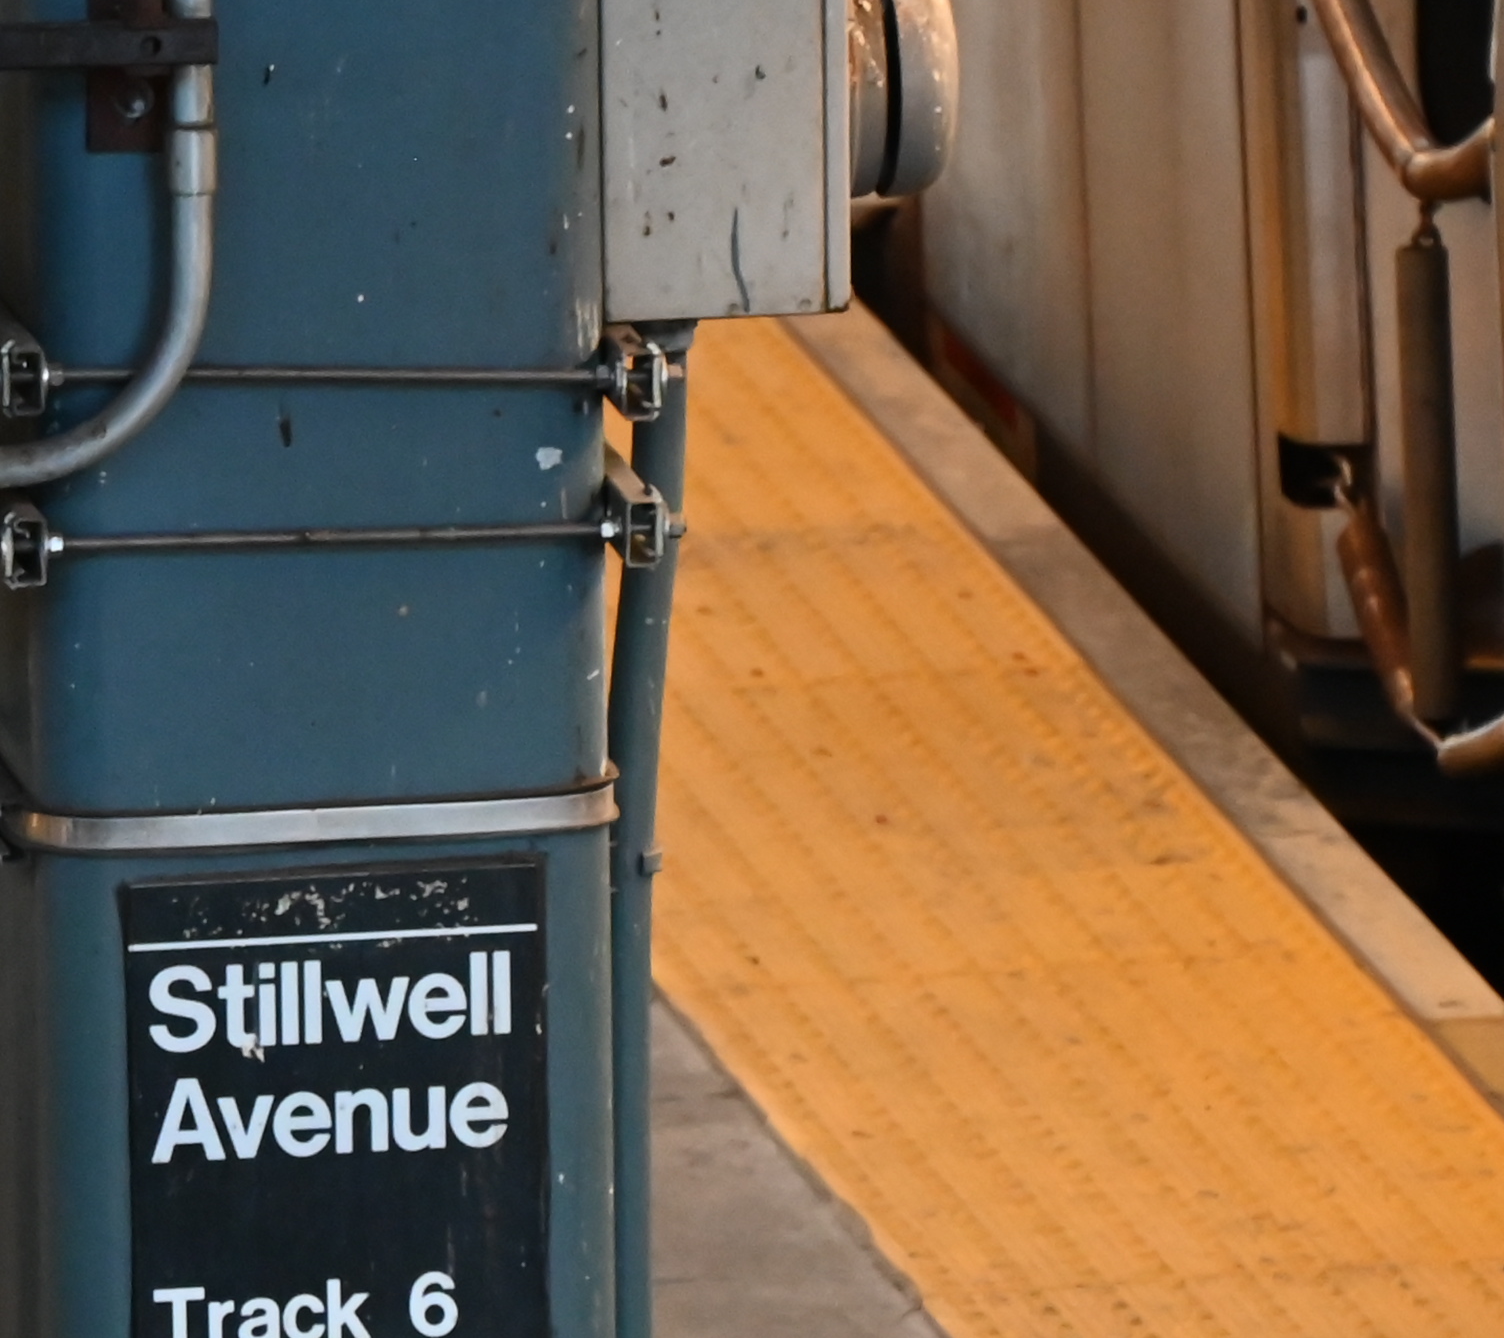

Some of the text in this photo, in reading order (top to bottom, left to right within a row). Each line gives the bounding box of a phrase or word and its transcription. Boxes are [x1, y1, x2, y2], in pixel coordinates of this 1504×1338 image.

[149, 949, 512, 1055] Stillwell
[151, 1077, 509, 1164] Avenue
[408, 1271, 460, 1338] 6
